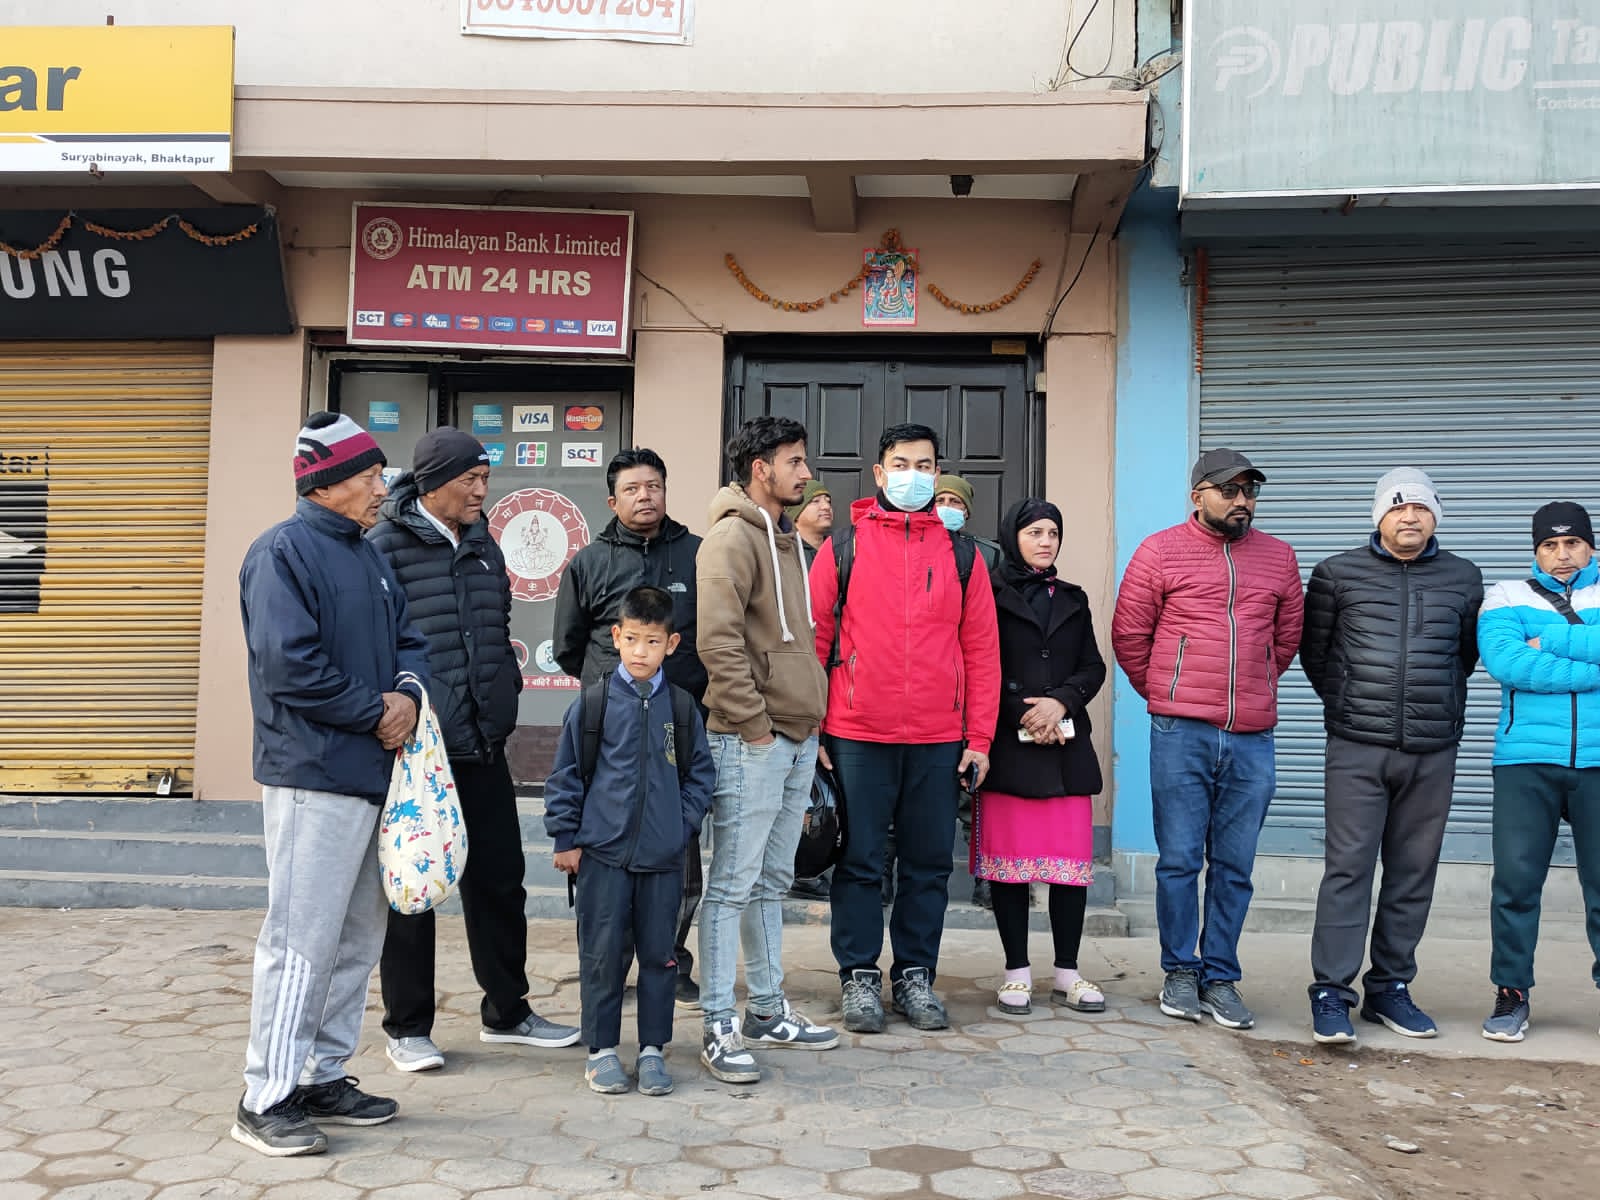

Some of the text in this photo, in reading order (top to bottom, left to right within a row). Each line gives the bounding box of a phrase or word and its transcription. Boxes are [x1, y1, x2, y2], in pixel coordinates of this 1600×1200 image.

[1282, 17, 1532, 96] PUBLIC
[0, 66, 82, 112] ar
[61, 152, 216, 165] Suryabinayak, Bhaktapur
[407, 226, 500, 254] Himalayan
[504, 231, 550, 254] Bank
[554, 233, 621, 257] Limited
[0, 248, 131, 299] UNG
[406, 264, 592, 297] ATM 24 HRS
[358, 313, 383, 323] SCT
[591, 323, 613, 333] VISA
[519, 412, 550, 425] VISA
[567, 448, 597, 460] SCT
